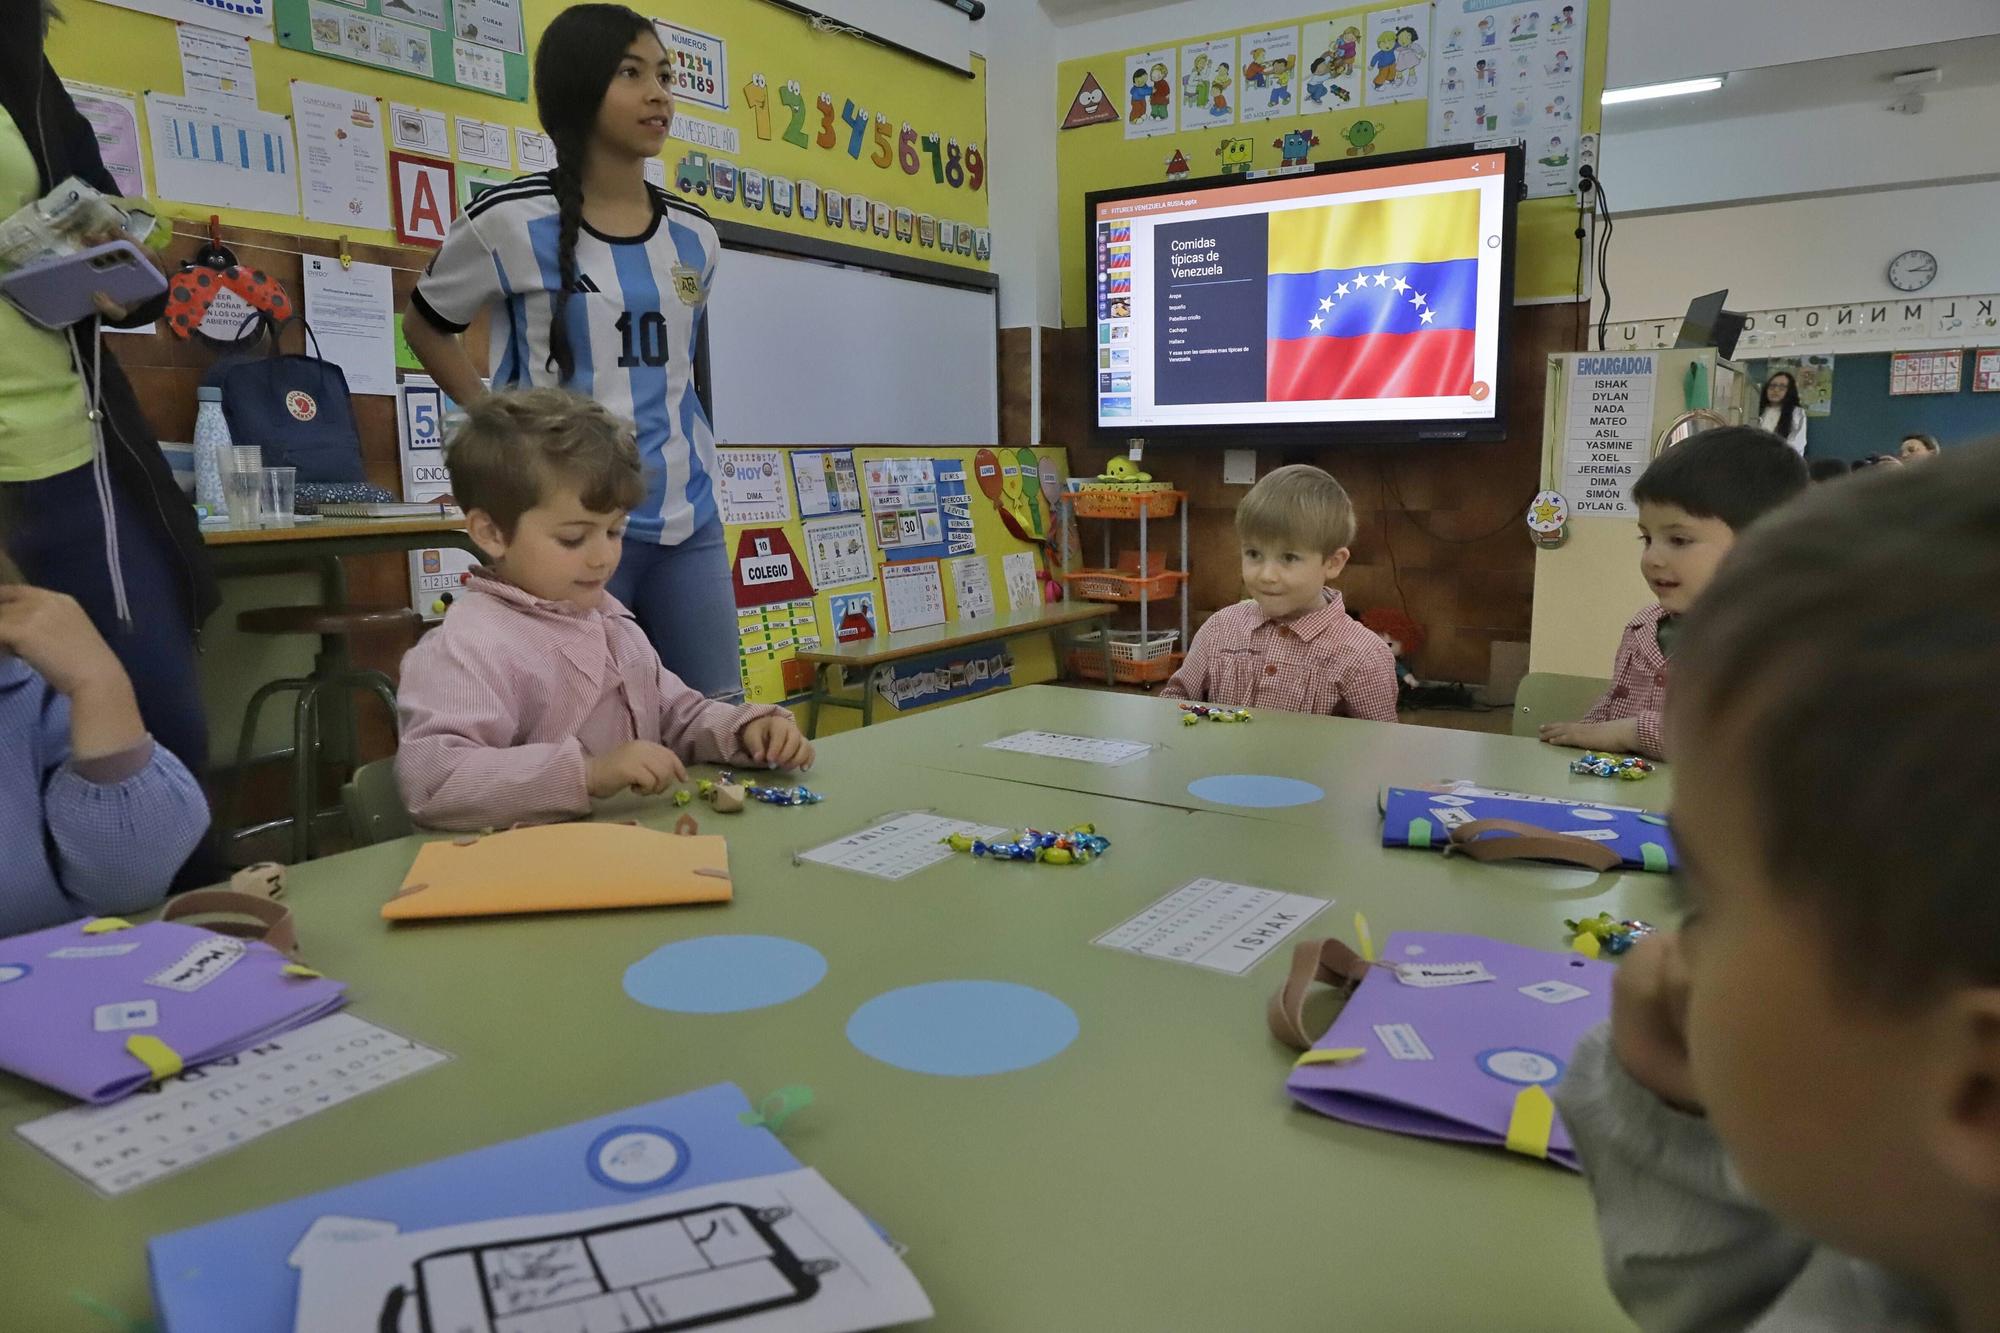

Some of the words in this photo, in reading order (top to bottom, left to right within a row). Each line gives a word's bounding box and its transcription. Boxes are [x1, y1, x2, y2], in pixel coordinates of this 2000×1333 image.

[672, 33, 707, 51] NÚMEROS
[708, 125, 721, 149] DEL
[410, 170, 445, 236] A
[1135, 201, 1167, 211] VENEZUELA
[1171, 238, 1216, 251] Comidas
[1171, 252, 1204, 266] típicas
[1206, 251, 1220, 261] de
[1171, 264, 1222, 278] Venezuela
[682, 276, 698, 294] AFA
[614, 312, 669, 368] 10
[1577, 356, 1652, 376] ENCARGADO/A
[1595, 380, 1628, 388] ISHAK
[1594, 405, 1624, 413] NADA
[415, 405, 434, 438] 5
[1590, 417, 1627, 425] MATEO
[1586, 441, 1633, 450] YASMINE
[1591, 454, 1619, 462] XOEL
[737, 467, 761, 480] HOY
[1578, 464, 1632, 474] JEREMÍAS
[1590, 478, 1616, 486] DIMA
[1586, 488, 1620, 498] SIMÓN
[1578, 502, 1613, 510] DYLAN
[1616, 503, 1627, 511] G.
[904, 520, 915, 533] 30
[759, 541, 767, 551] 10
[951, 543, 973, 552] DOMINGO
[748, 564, 788, 580] COLEGIO
[433, 576, 440, 586] 2
[444, 576, 449, 586] 3
[453, 576, 459, 586] 4
[851, 602, 856, 610] 1
[840, 825, 899, 846] DIMA
[1233, 912, 1298, 952] ISHAK
